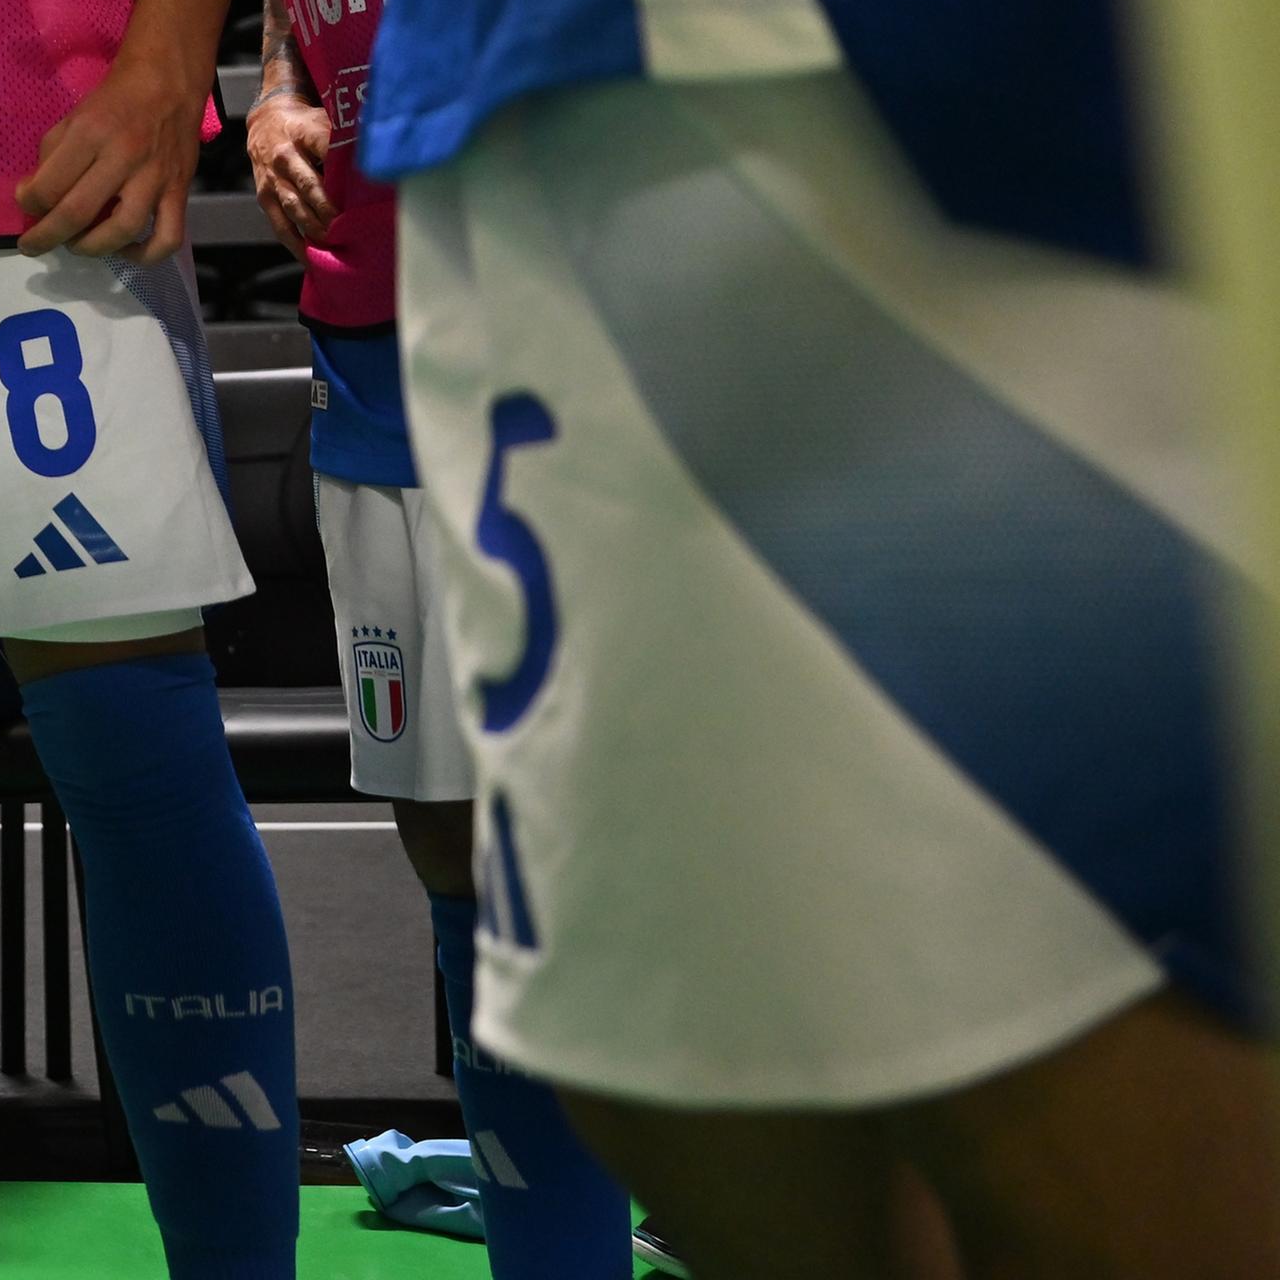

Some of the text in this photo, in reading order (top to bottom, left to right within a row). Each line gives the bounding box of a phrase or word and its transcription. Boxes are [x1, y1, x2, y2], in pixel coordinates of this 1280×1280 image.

[474, 387, 562, 735] 5
[357, 650, 400, 670] ITALIA
[124, 984, 284, 1020] ITALIA
